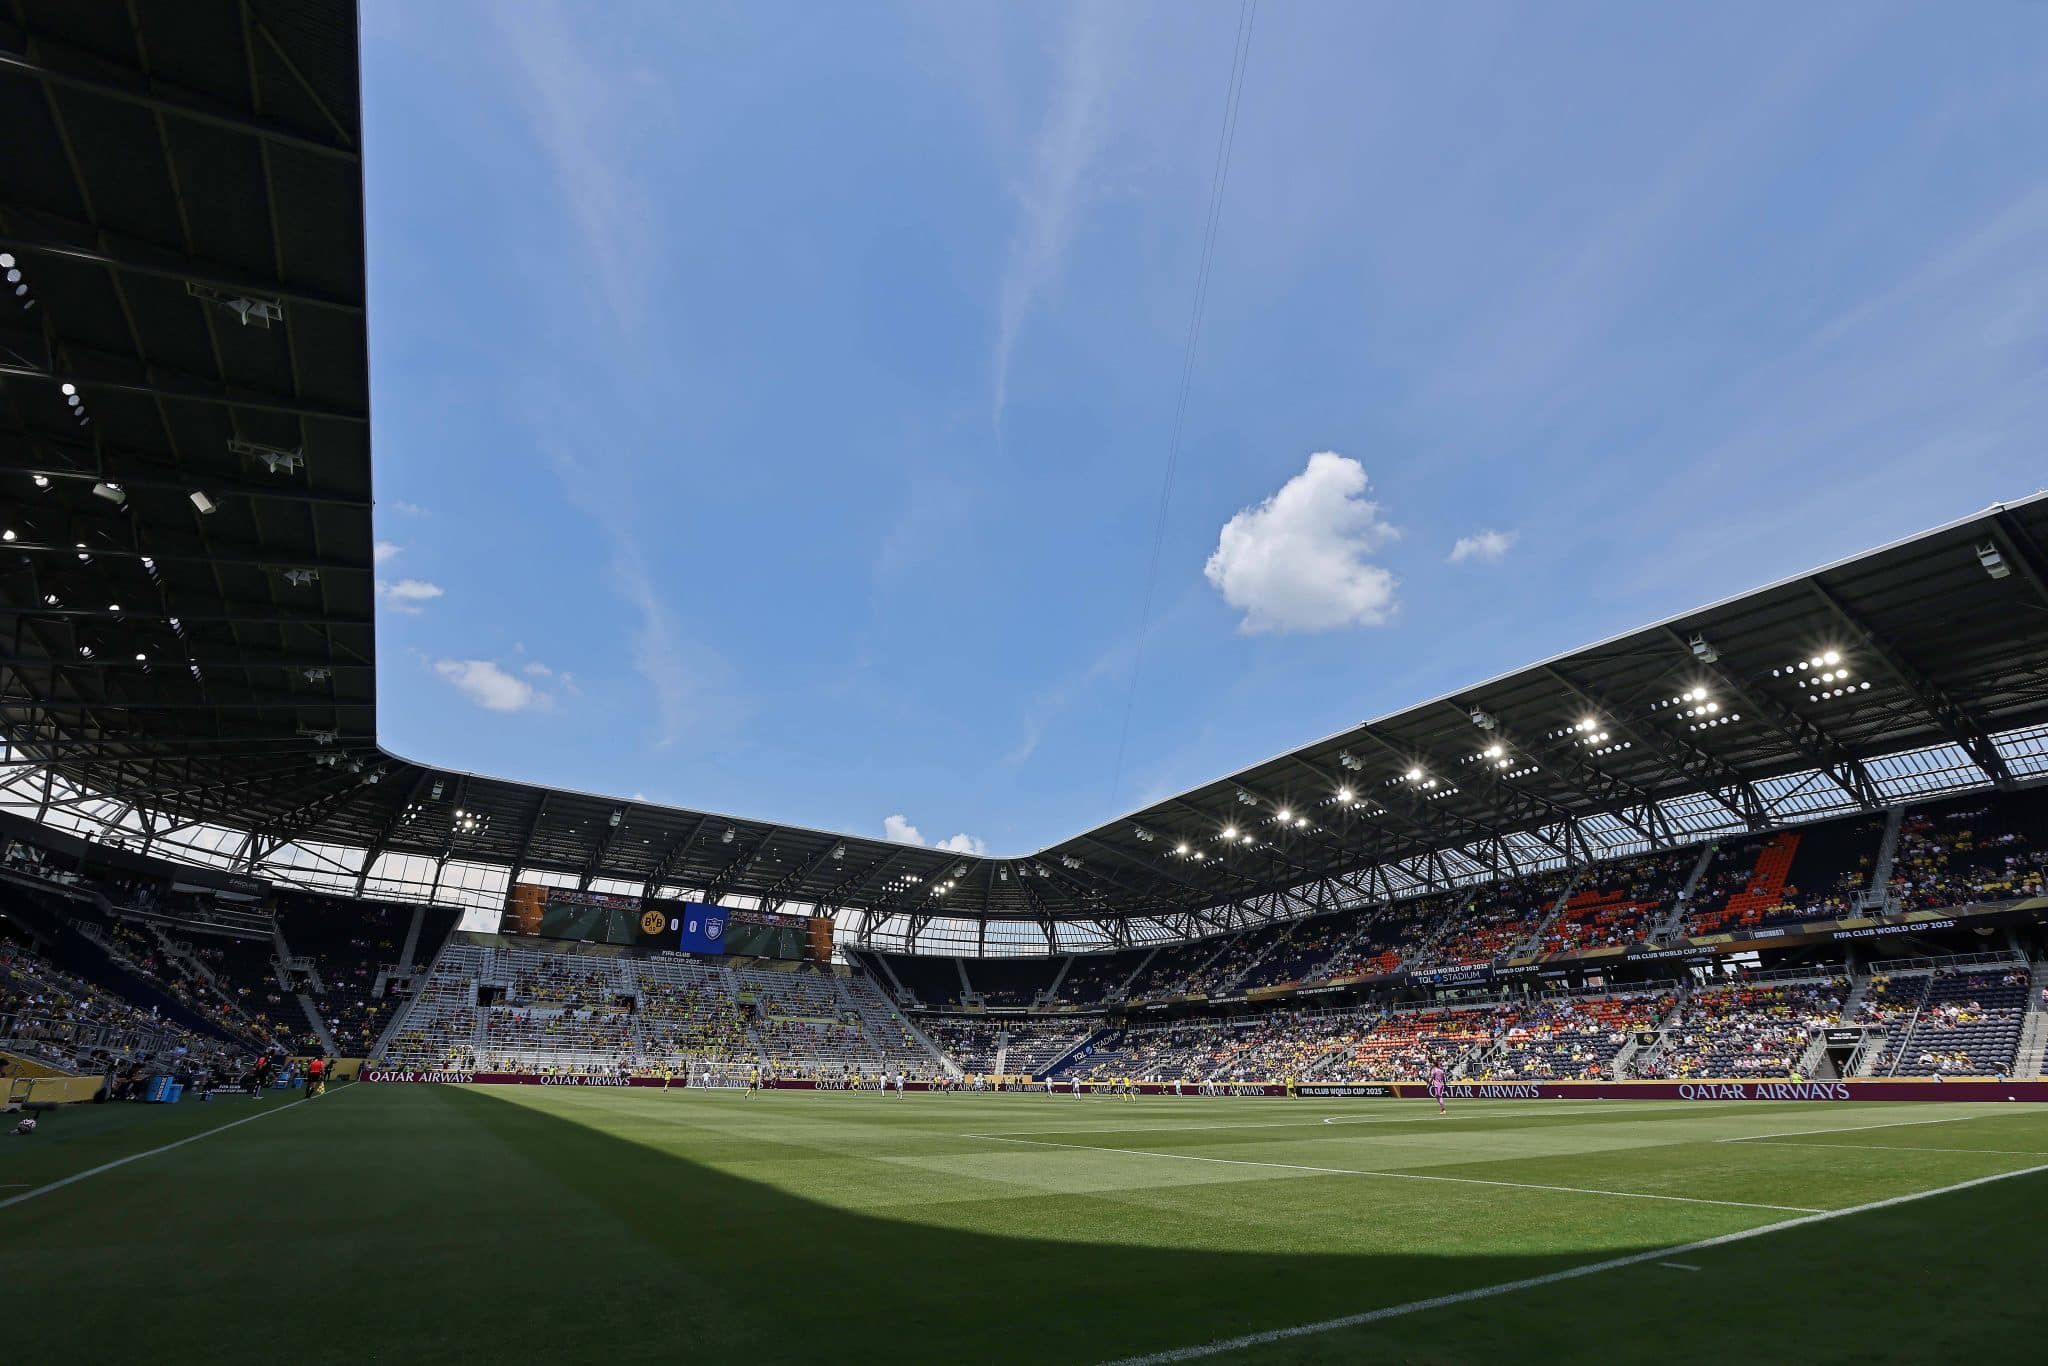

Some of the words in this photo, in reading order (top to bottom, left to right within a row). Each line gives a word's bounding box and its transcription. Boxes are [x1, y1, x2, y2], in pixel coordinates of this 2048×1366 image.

[645, 913, 662, 928] BVB
[670, 918, 679, 931] 0
[689, 920, 698, 933] 0
[1833, 931, 1853, 939] FIFA
[1875, 926, 1909, 935] WORLD
[1910, 923, 1929, 931] CUP
[1930, 920, 1955, 929] 2025
[1641, 952, 1658, 960] CLUB
[1658, 950, 1682, 958] WORLD
[1442, 970, 1481, 982] STADIUM
[1072, 1051, 1087, 1062] TQL
[1092, 1031, 1120, 1049] STADIUM
[369, 1071, 415, 1082] QATAR
[418, 1072, 473, 1083] AIRWAYS
[540, 1075, 579, 1085] QATAR
[583, 1075, 631, 1086] AIRWAYS
[815, 1081, 845, 1090] QATAR
[1314, 1087, 1329, 1095] CLUB
[1330, 1087, 1352, 1095] WORLD
[1353, 1087, 1366, 1095] CUP
[1478, 1085, 1540, 1097] AIRWAYS
[1679, 1084, 1747, 1100] QATAR
[1755, 1084, 1850, 1099] AIRWAYS
